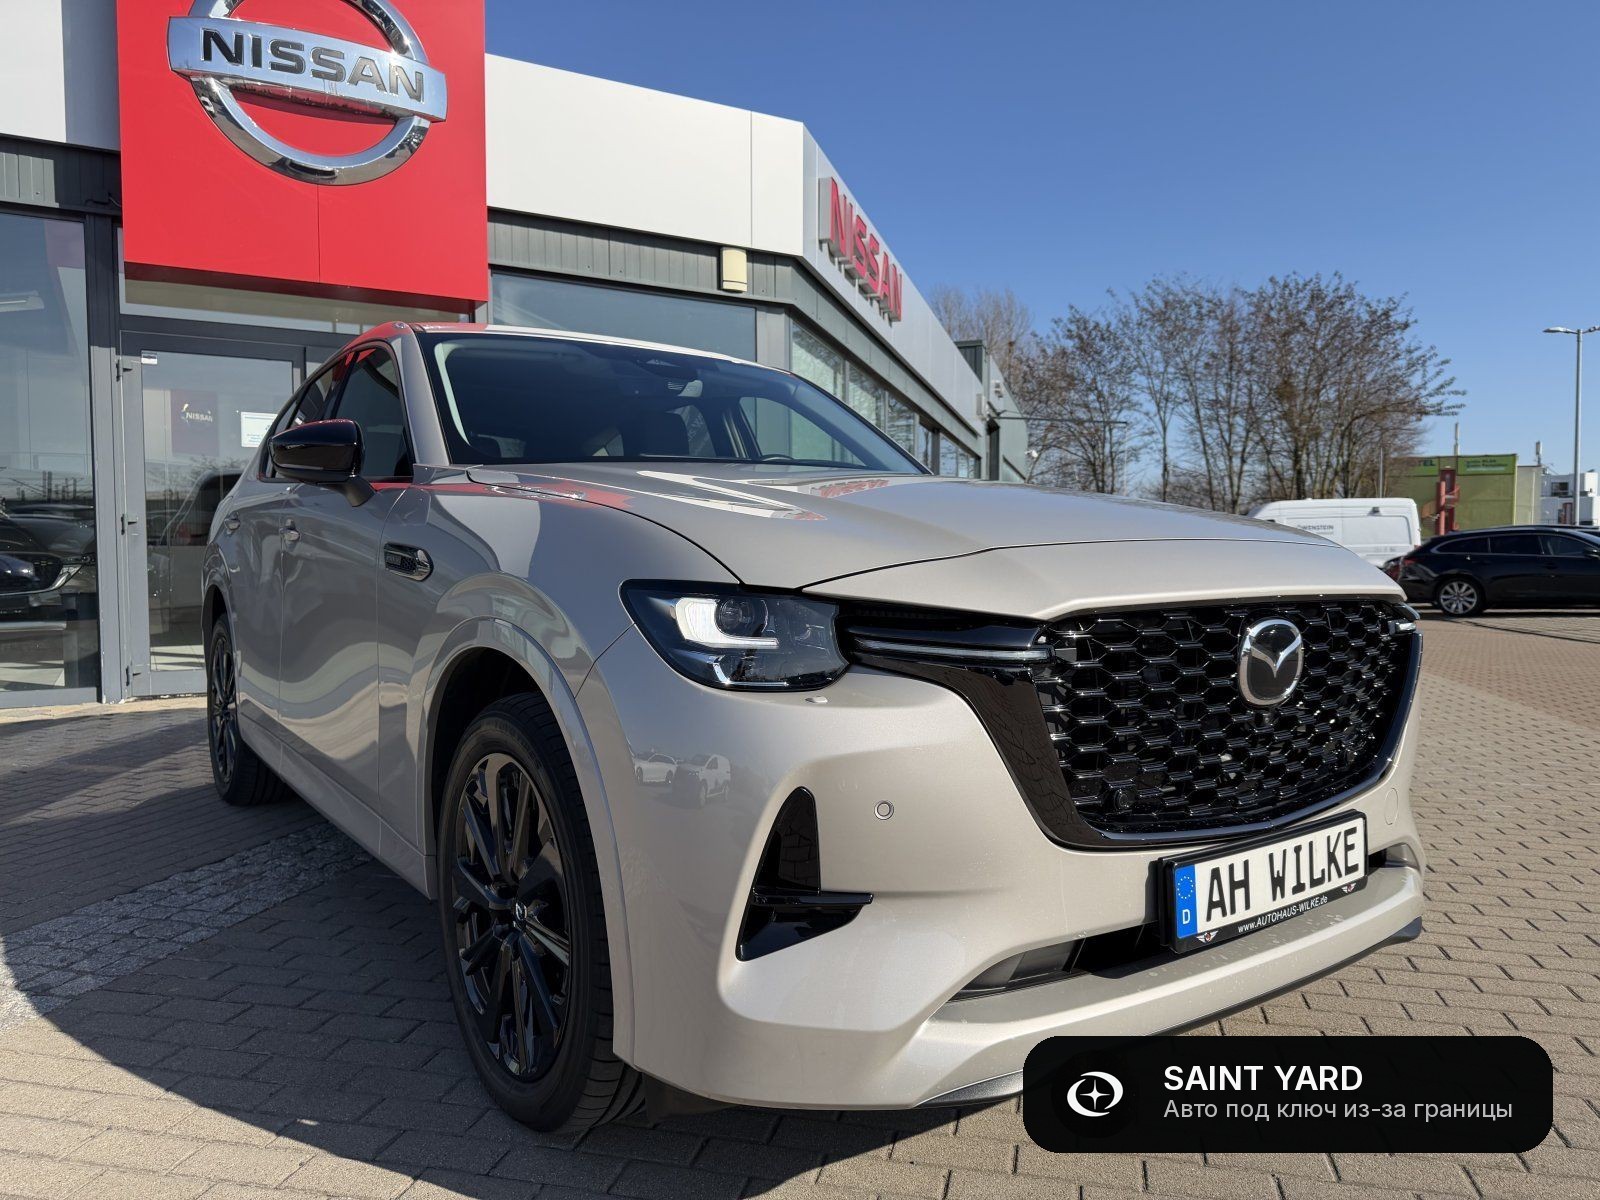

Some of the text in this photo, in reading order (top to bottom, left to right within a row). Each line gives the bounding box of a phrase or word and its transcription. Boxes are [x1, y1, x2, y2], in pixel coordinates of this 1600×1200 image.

[201, 27, 425, 104] NISSAN
[826, 176, 903, 323] NISSAN
[185, 411, 213, 423] NISSAN
[1205, 826, 1360, 923] AH WILKE
[1182, 908, 1191, 926] D
[1237, 895, 1328, 934] www.AUTOHAUS-WILKE.de
